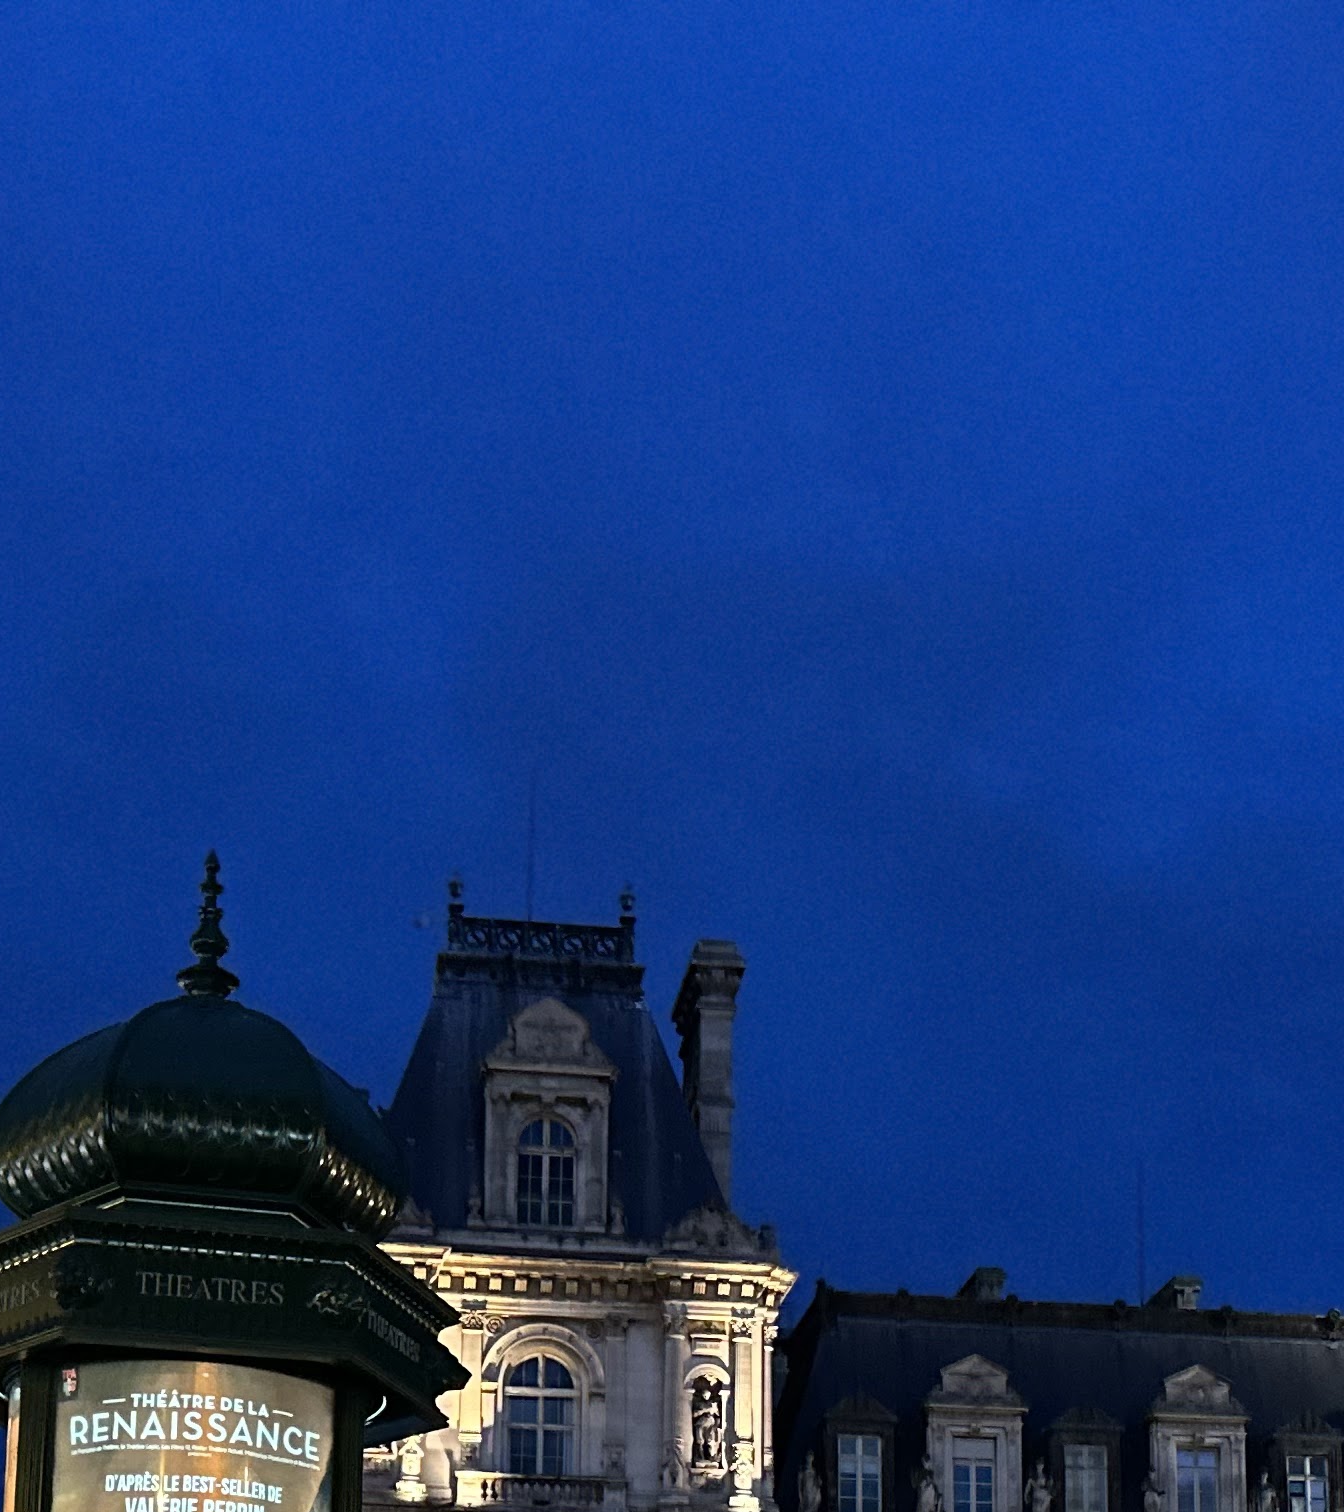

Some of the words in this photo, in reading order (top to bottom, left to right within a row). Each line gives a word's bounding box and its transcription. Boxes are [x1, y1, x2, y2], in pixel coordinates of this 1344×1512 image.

[136, 1271, 285, 1305] THEATRES
[130, 1389, 216, 1410] THÉÂTRE
[220, 1396, 244, 1413] DE
[248, 1400, 269, 1418] LA
[70, 1410, 320, 1462] RENAISSANCE
[105, 1471, 159, 1492] D'APRÈS
[163, 1474, 179, 1492] LE
[182, 1474, 266, 1498] BEST-SELLER
[268, 1485, 283, 1503] DE
